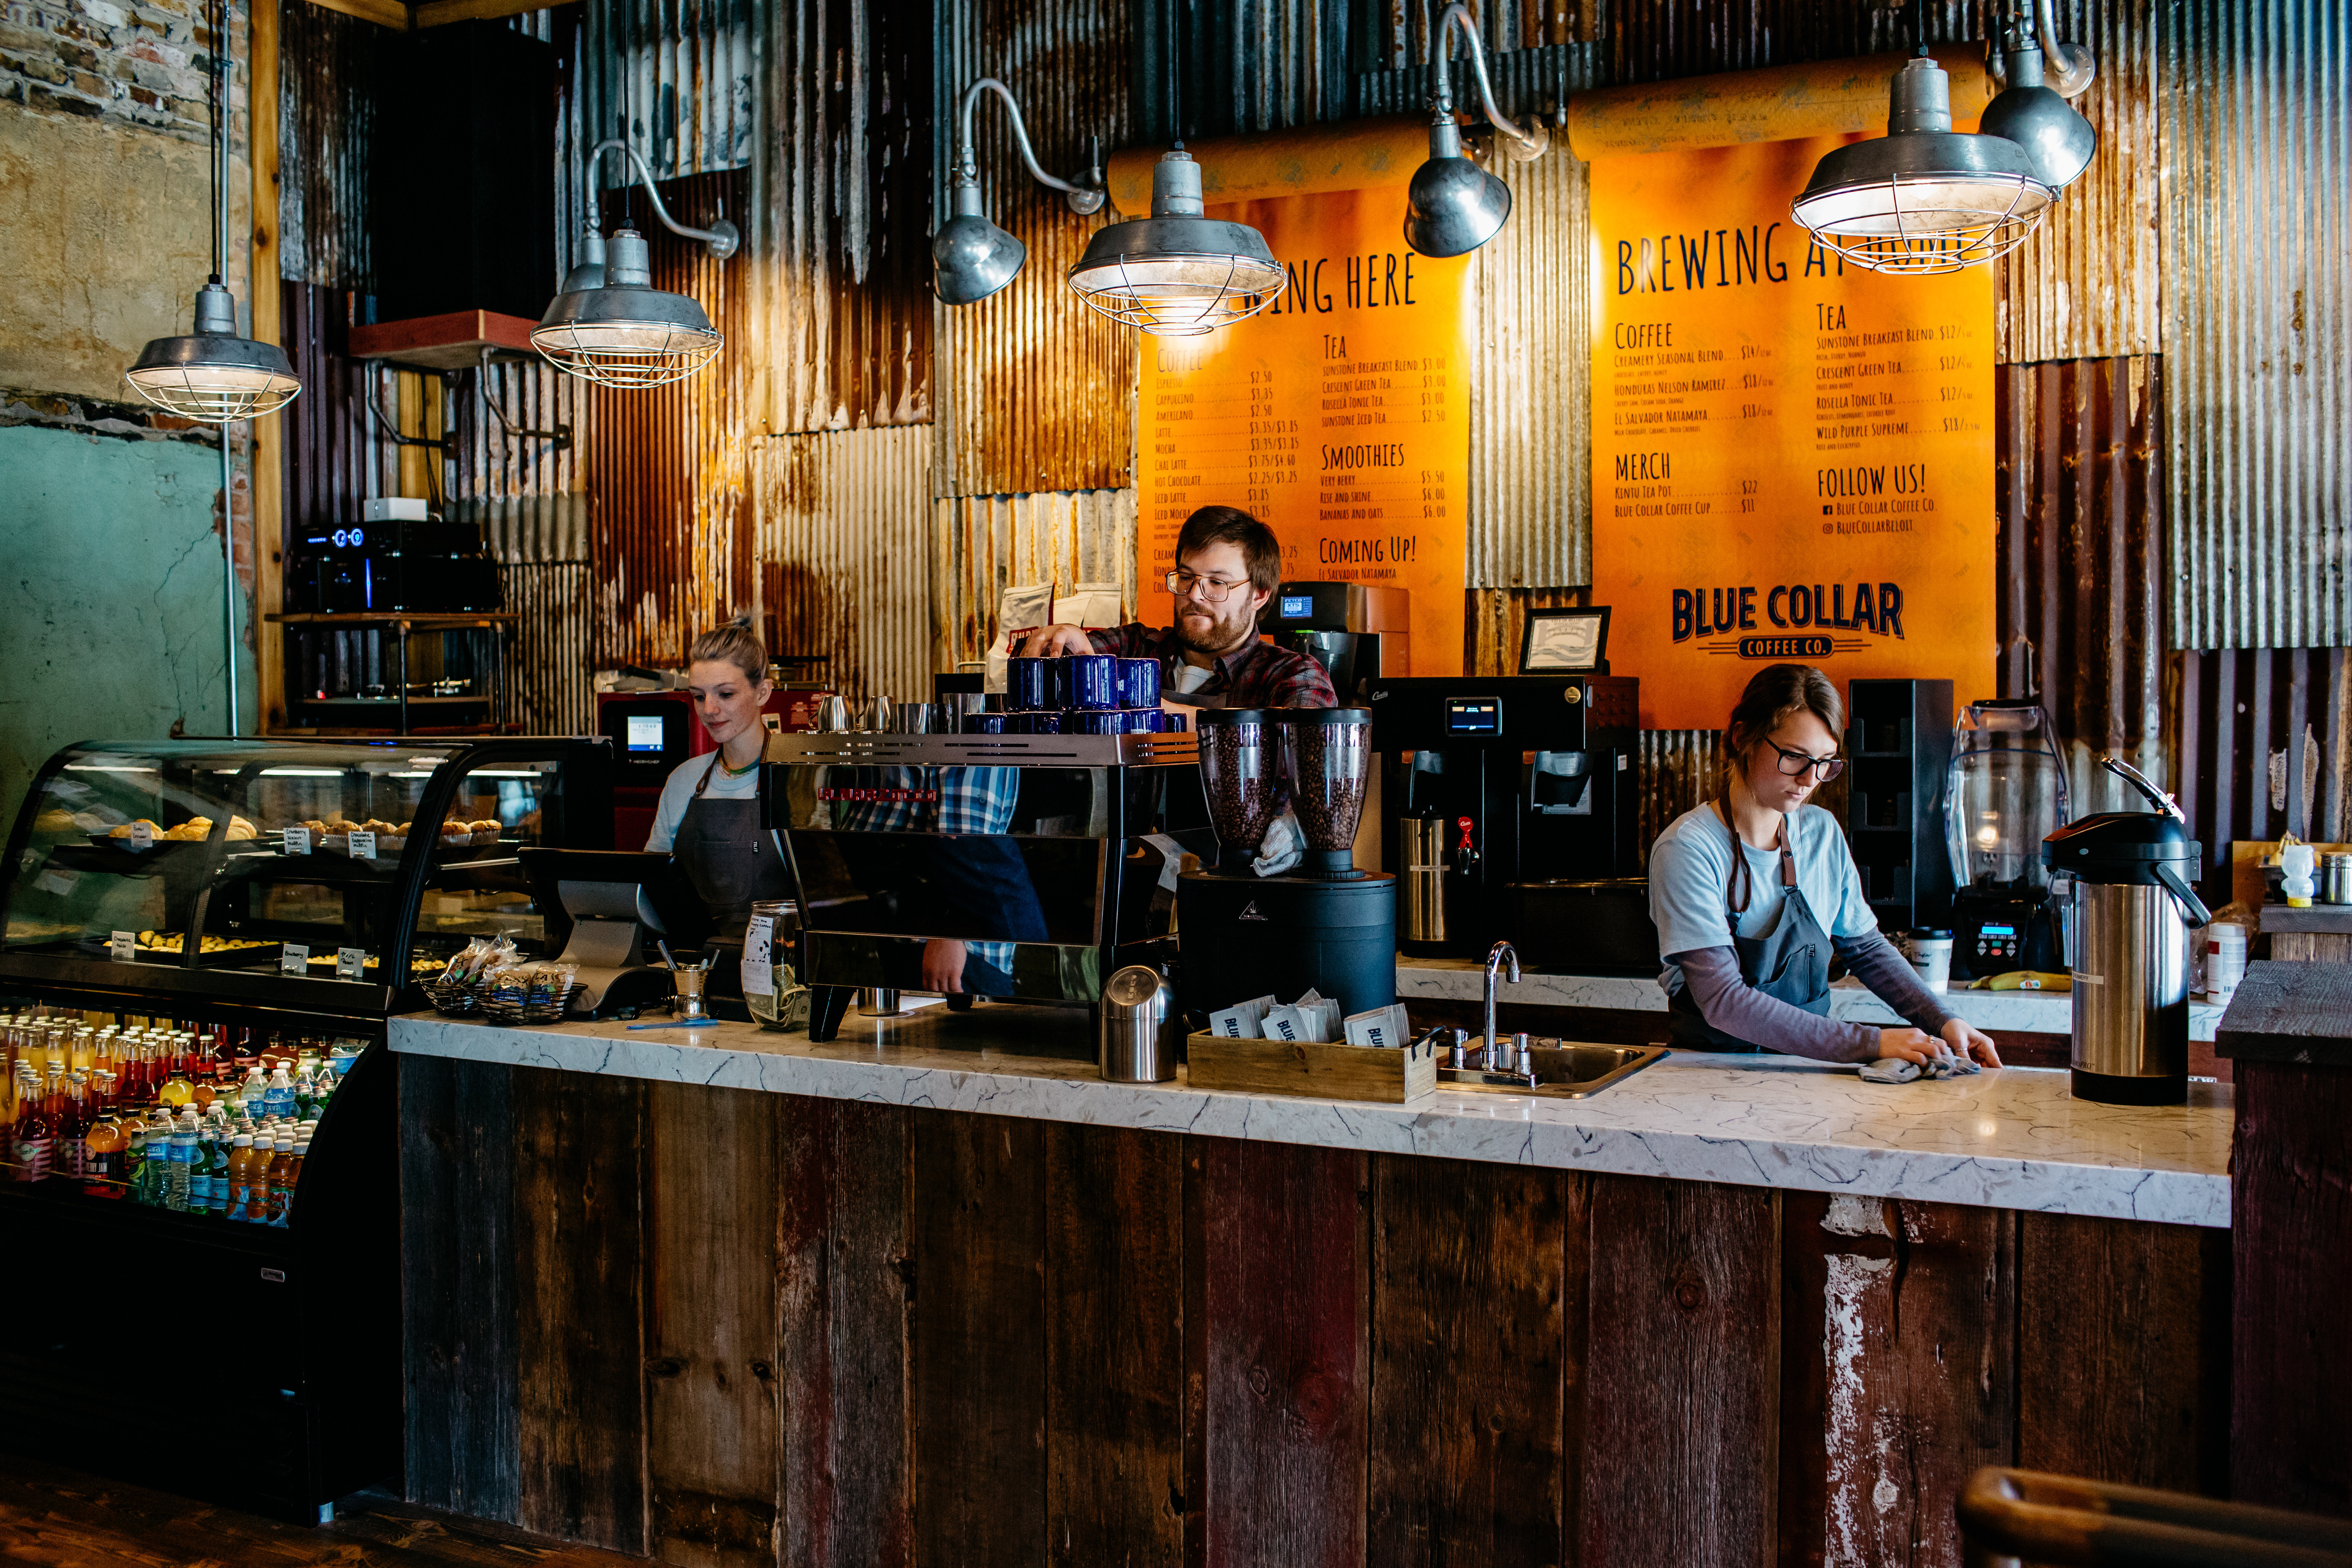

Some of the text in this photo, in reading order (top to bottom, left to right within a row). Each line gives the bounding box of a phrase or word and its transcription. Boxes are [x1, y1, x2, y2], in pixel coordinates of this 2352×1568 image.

[1618, 223, 1788, 295] BREWING
[1347, 251, 1417, 309] HERE
[1816, 303, 1846, 330] TEA
[1615, 323, 1673, 349] COFFEE
[1817, 336, 1860, 350] SUNSTONE
[1863, 330, 1904, 346] BREAKFAST
[1907, 328, 1934, 342] BLEND
[1323, 334, 1346, 359] TEA
[1157, 348, 1203, 372] COFFEE
[1358, 361, 1392, 374] BREAKFAST
[1395, 359, 1418, 371] BLEND
[1614, 354, 1654, 368] CREAMERY
[1657, 352, 1695, 365] SEASONAL
[1698, 349, 1724, 363] BLEND
[1816, 365, 1855, 380] CRESCENT
[1858, 363, 1885, 377] GREEN
[1888, 361, 1902, 374] TEA
[1355, 378, 1376, 391] GREEN
[1379, 377, 1391, 389] TEA
[1615, 382, 1655, 396] HONDURAS
[1658, 380, 1688, 394] NELSON
[1691, 378, 1726, 392] RAMIREZ
[1372, 395, 1383, 407] TEA
[1816, 396, 1849, 410] ROSELLA
[1851, 393, 1876, 408] TONIC
[1879, 391, 1893, 405] TEA
[1357, 412, 1372, 425] ICED
[1374, 412, 1387, 424] TEA
[1615, 412, 1621, 425] EL
[1625, 411, 1663, 425] SALVADOR
[1666, 409, 1708, 423] NATAMAYA
[1155, 427, 1171, 438] LATTE
[1816, 425, 1838, 440] WILD
[1840, 424, 1868, 438] PURPLE
[1871, 422, 1909, 437] SUPREME
[1155, 443, 1176, 454] MOCHA
[1321, 443, 1404, 470] SMOOTHIES
[1155, 459, 1169, 470] CHAI
[1171, 459, 1187, 470] LATTE
[1616, 452, 1670, 481] MERCH
[1155, 476, 1166, 487] HOT
[1167, 475, 1201, 487] CHOCOLATE
[1320, 474, 1335, 487] VERY
[1818, 463, 1925, 497] FOLLOW US!
[1154, 492, 1168, 504] ICED
[1170, 492, 1186, 503] LATTE
[1320, 492, 1333, 504] RISE
[1334, 491, 1349, 503] AND
[1351, 491, 1371, 503] SHINE
[1615, 486, 1639, 499] KINTU
[1642, 485, 1655, 498] TEA
[1658, 484, 1672, 497] POT
[1154, 508, 1168, 520] ICED
[1320, 509, 1350, 521] BANANAS
[1351, 508, 1366, 520] AND
[1368, 508, 1383, 519] OATS
[1615, 504, 1633, 518] BLUE
[1635, 503, 1663, 517] COLLAR
[1666, 502, 1692, 515] COFFEE
[1695, 501, 1711, 514] CUP
[1837, 502, 1855, 516] BLUE
[1859, 500, 1888, 514] COLLAR
[1891, 499, 1920, 513] COFFEE
[1280, 546, 1297, 558] 3.25
[1320, 535, 1416, 564] COMING UP!
[1327, 568, 1359, 581] SALVADOR
[1673, 582, 1905, 644] BLUE COLLAR
[1747, 639, 1826, 655] COFFEE CO.
[1224, 1018, 1240, 1038] BLUE
[1276, 1020, 1296, 1041] BLUE
